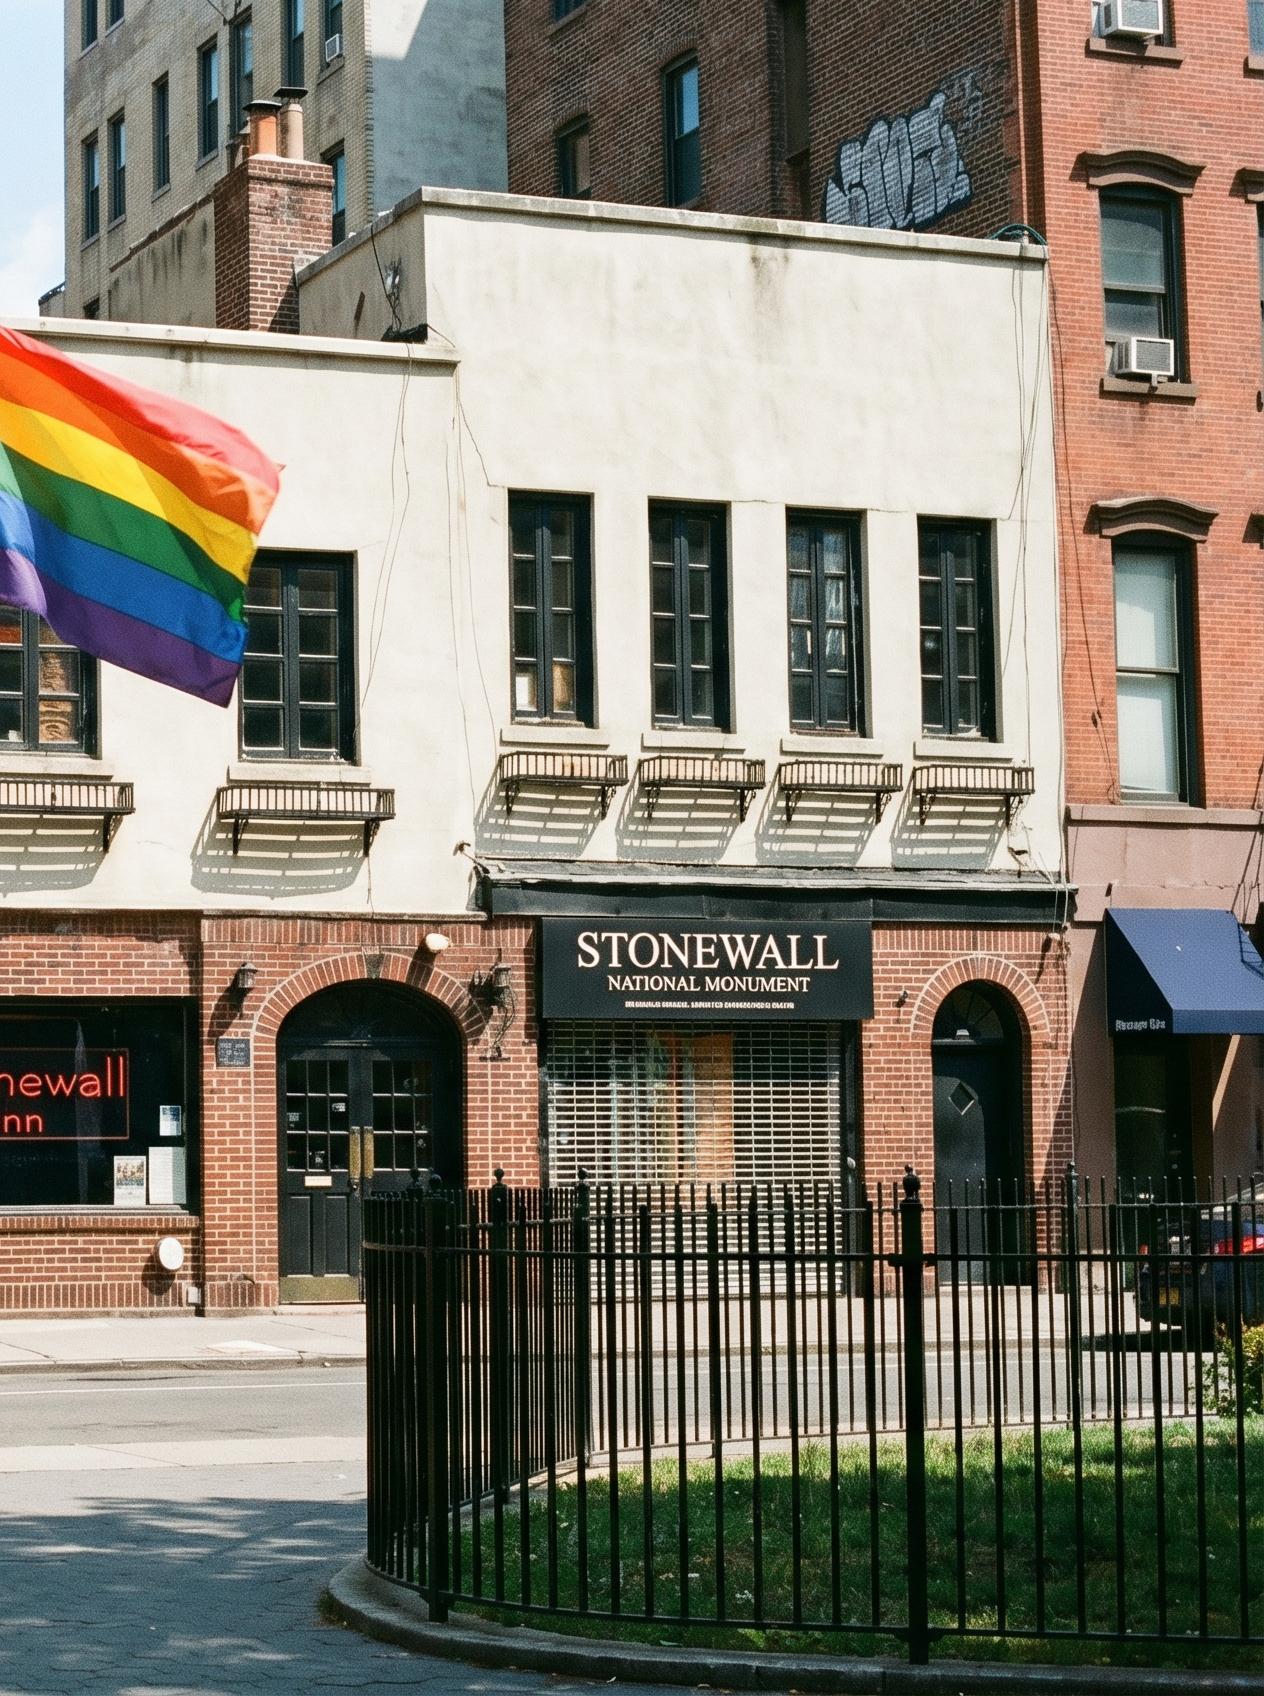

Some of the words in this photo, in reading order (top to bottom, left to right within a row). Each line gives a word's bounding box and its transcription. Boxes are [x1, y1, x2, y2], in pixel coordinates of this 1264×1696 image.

[577, 931, 840, 970] STONEWALL
[607, 975, 701, 992] NATIONAL
[705, 976, 811, 993] MONUMENT
